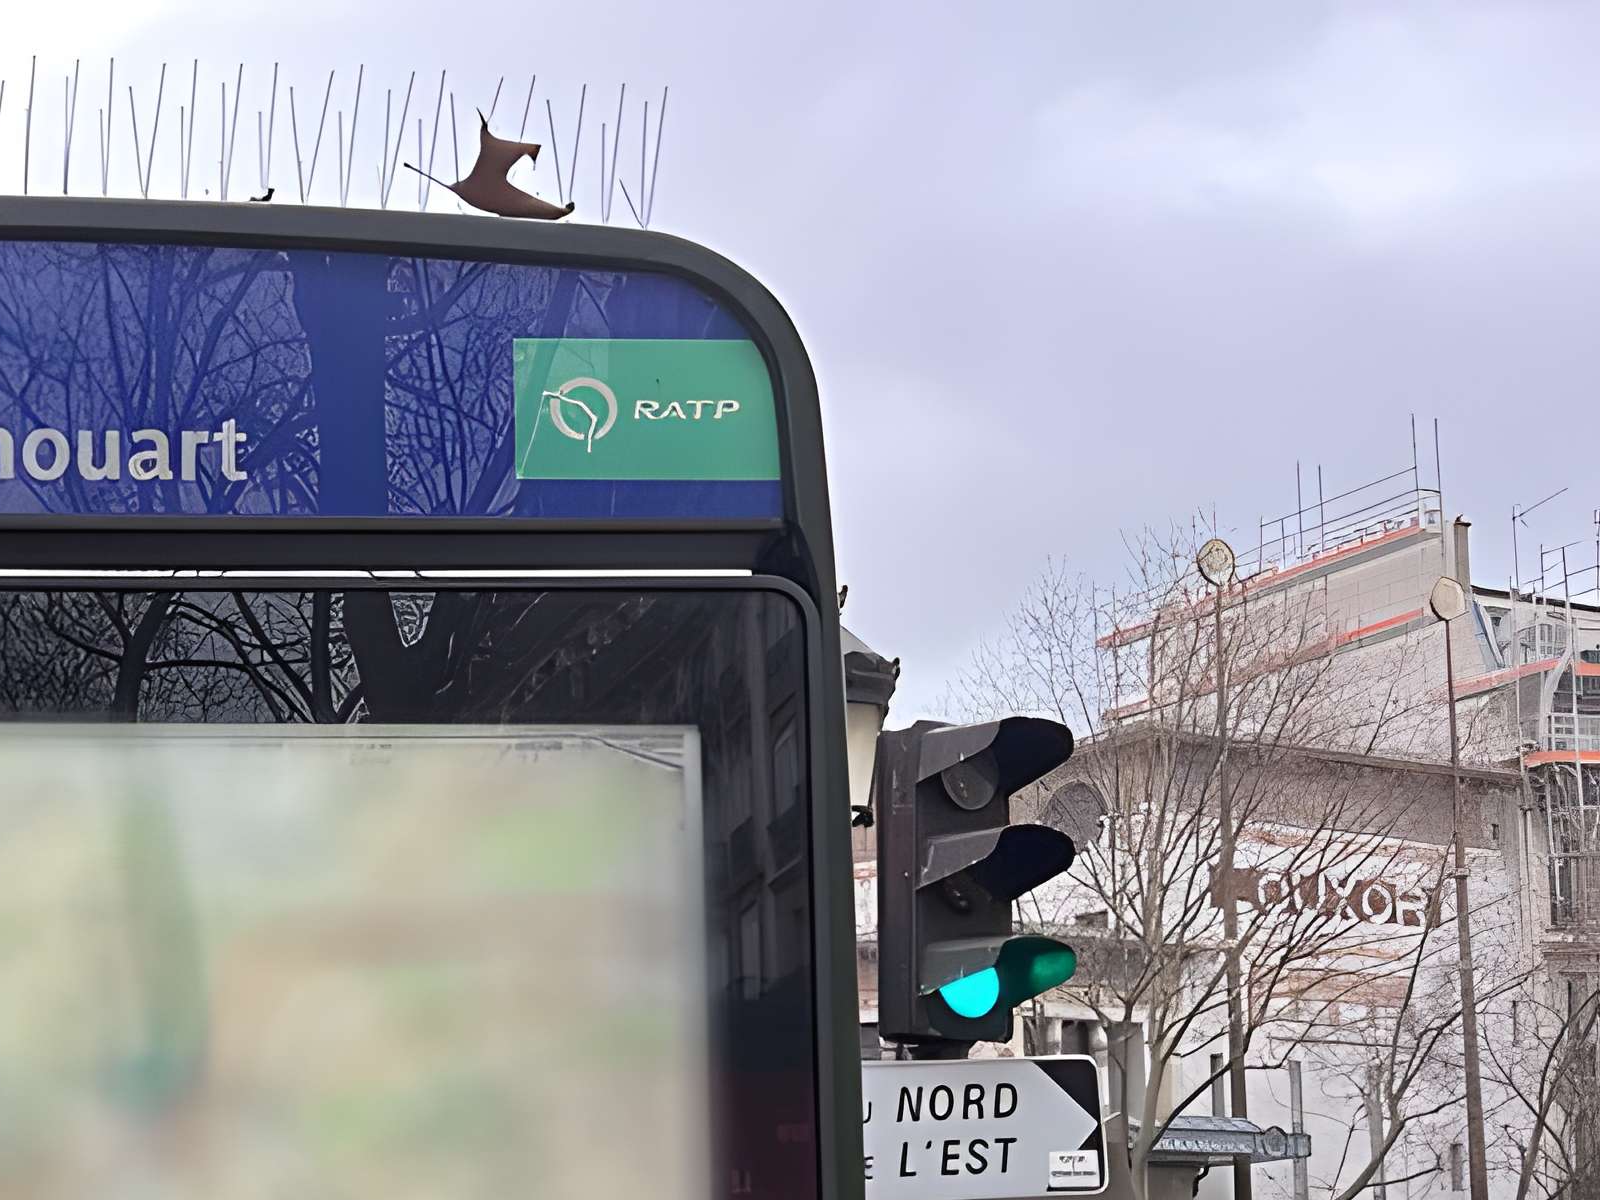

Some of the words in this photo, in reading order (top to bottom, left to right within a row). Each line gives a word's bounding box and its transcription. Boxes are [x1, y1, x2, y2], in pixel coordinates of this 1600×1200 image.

[633, 399, 740, 420] RATP
[1226, 868, 1428, 927] OUXOR
[896, 1082, 1018, 1123] NORD
[899, 1137, 1017, 1177] L'EST
